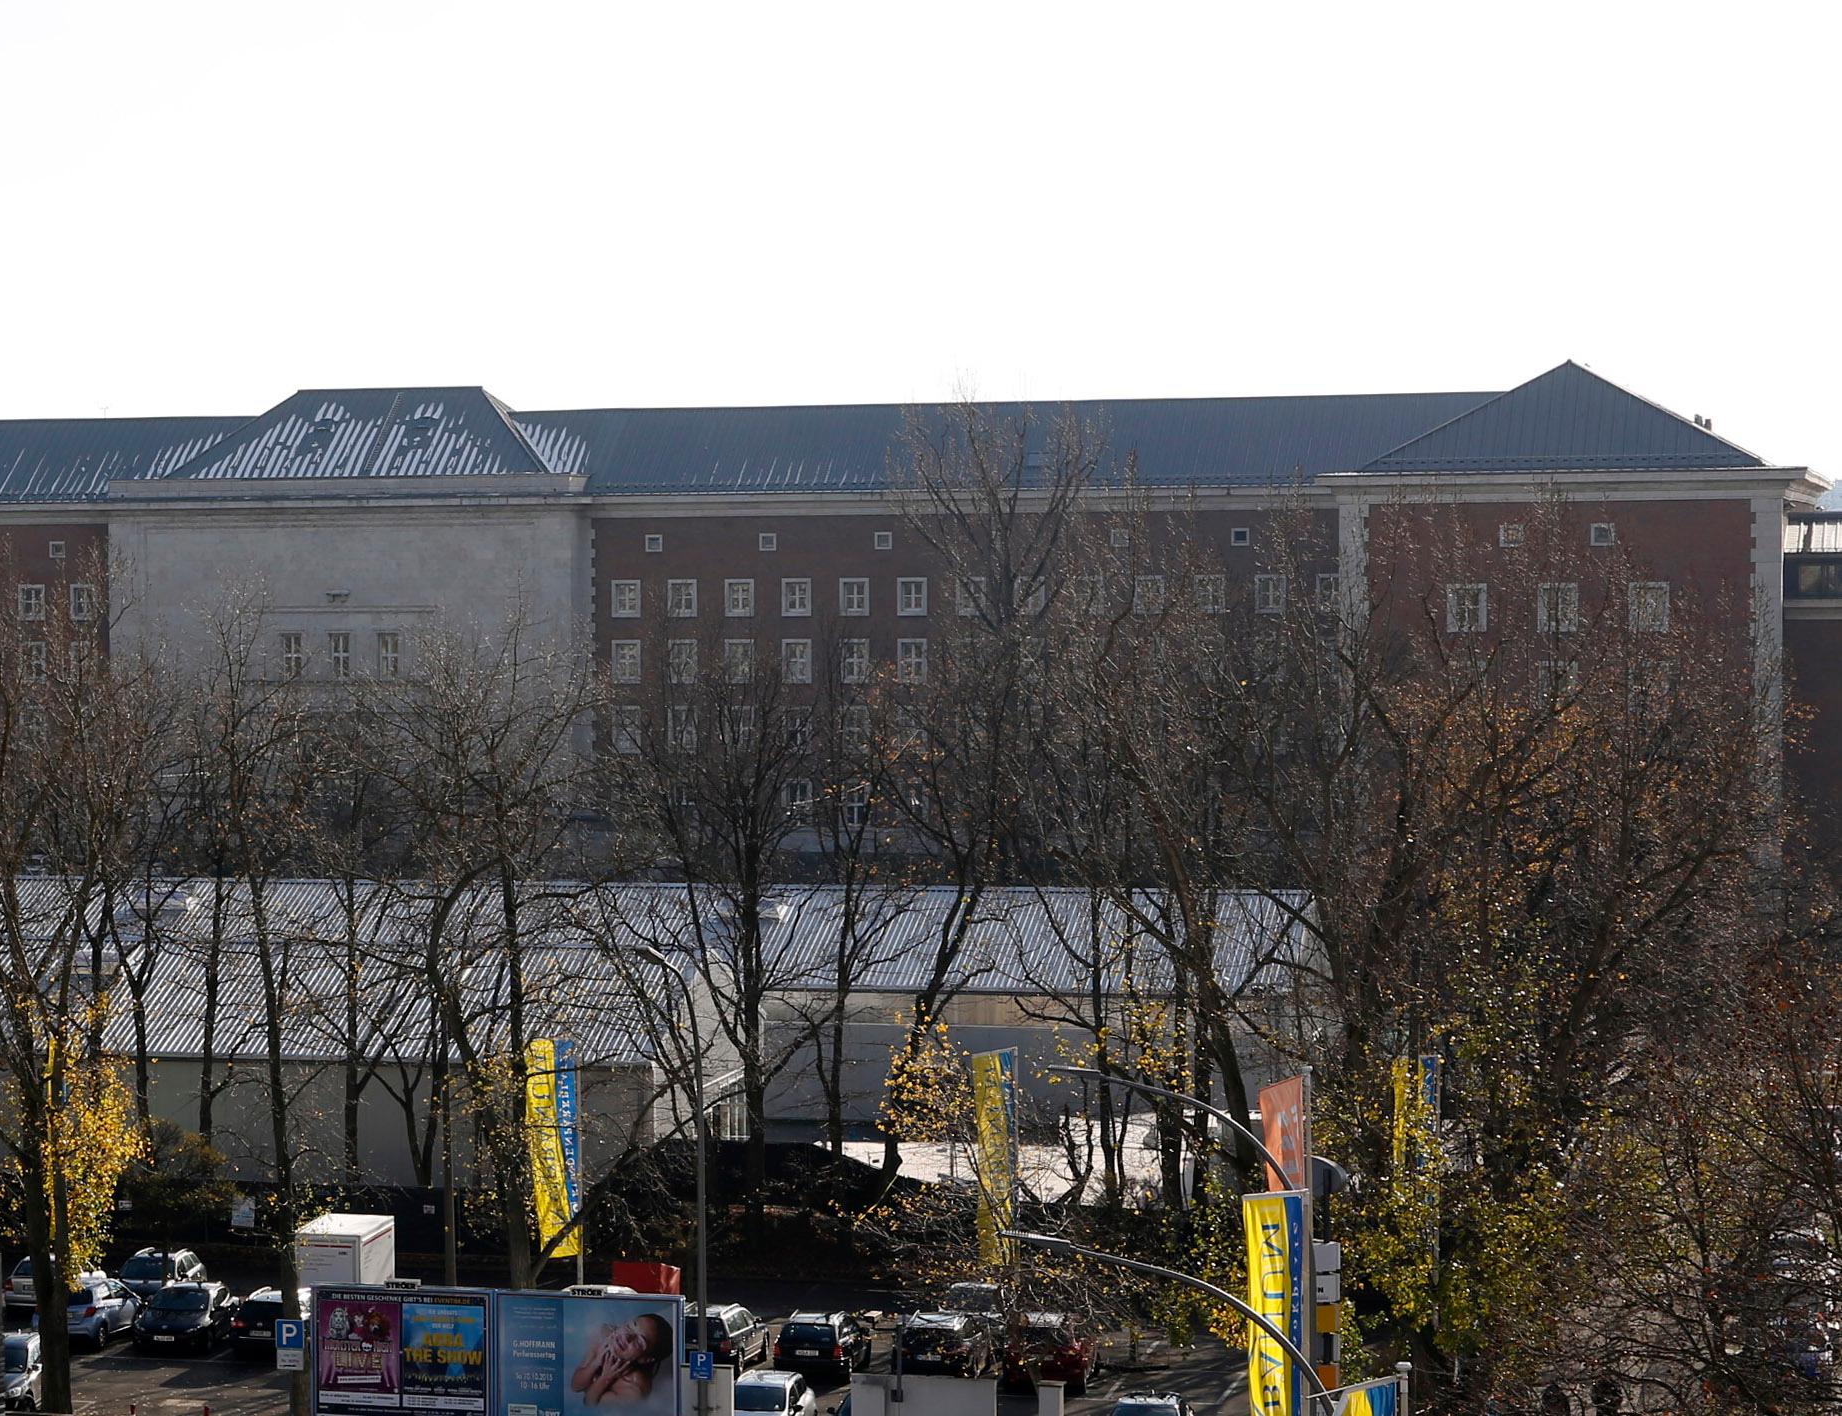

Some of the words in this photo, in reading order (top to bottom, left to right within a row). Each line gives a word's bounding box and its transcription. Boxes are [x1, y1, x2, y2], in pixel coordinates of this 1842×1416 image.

[571, 1288, 603, 1297] STRÖER
[334, 1352, 383, 1370] LIVE
[404, 1348, 433, 1363] THE
[437, 1349, 483, 1365] SHOW
